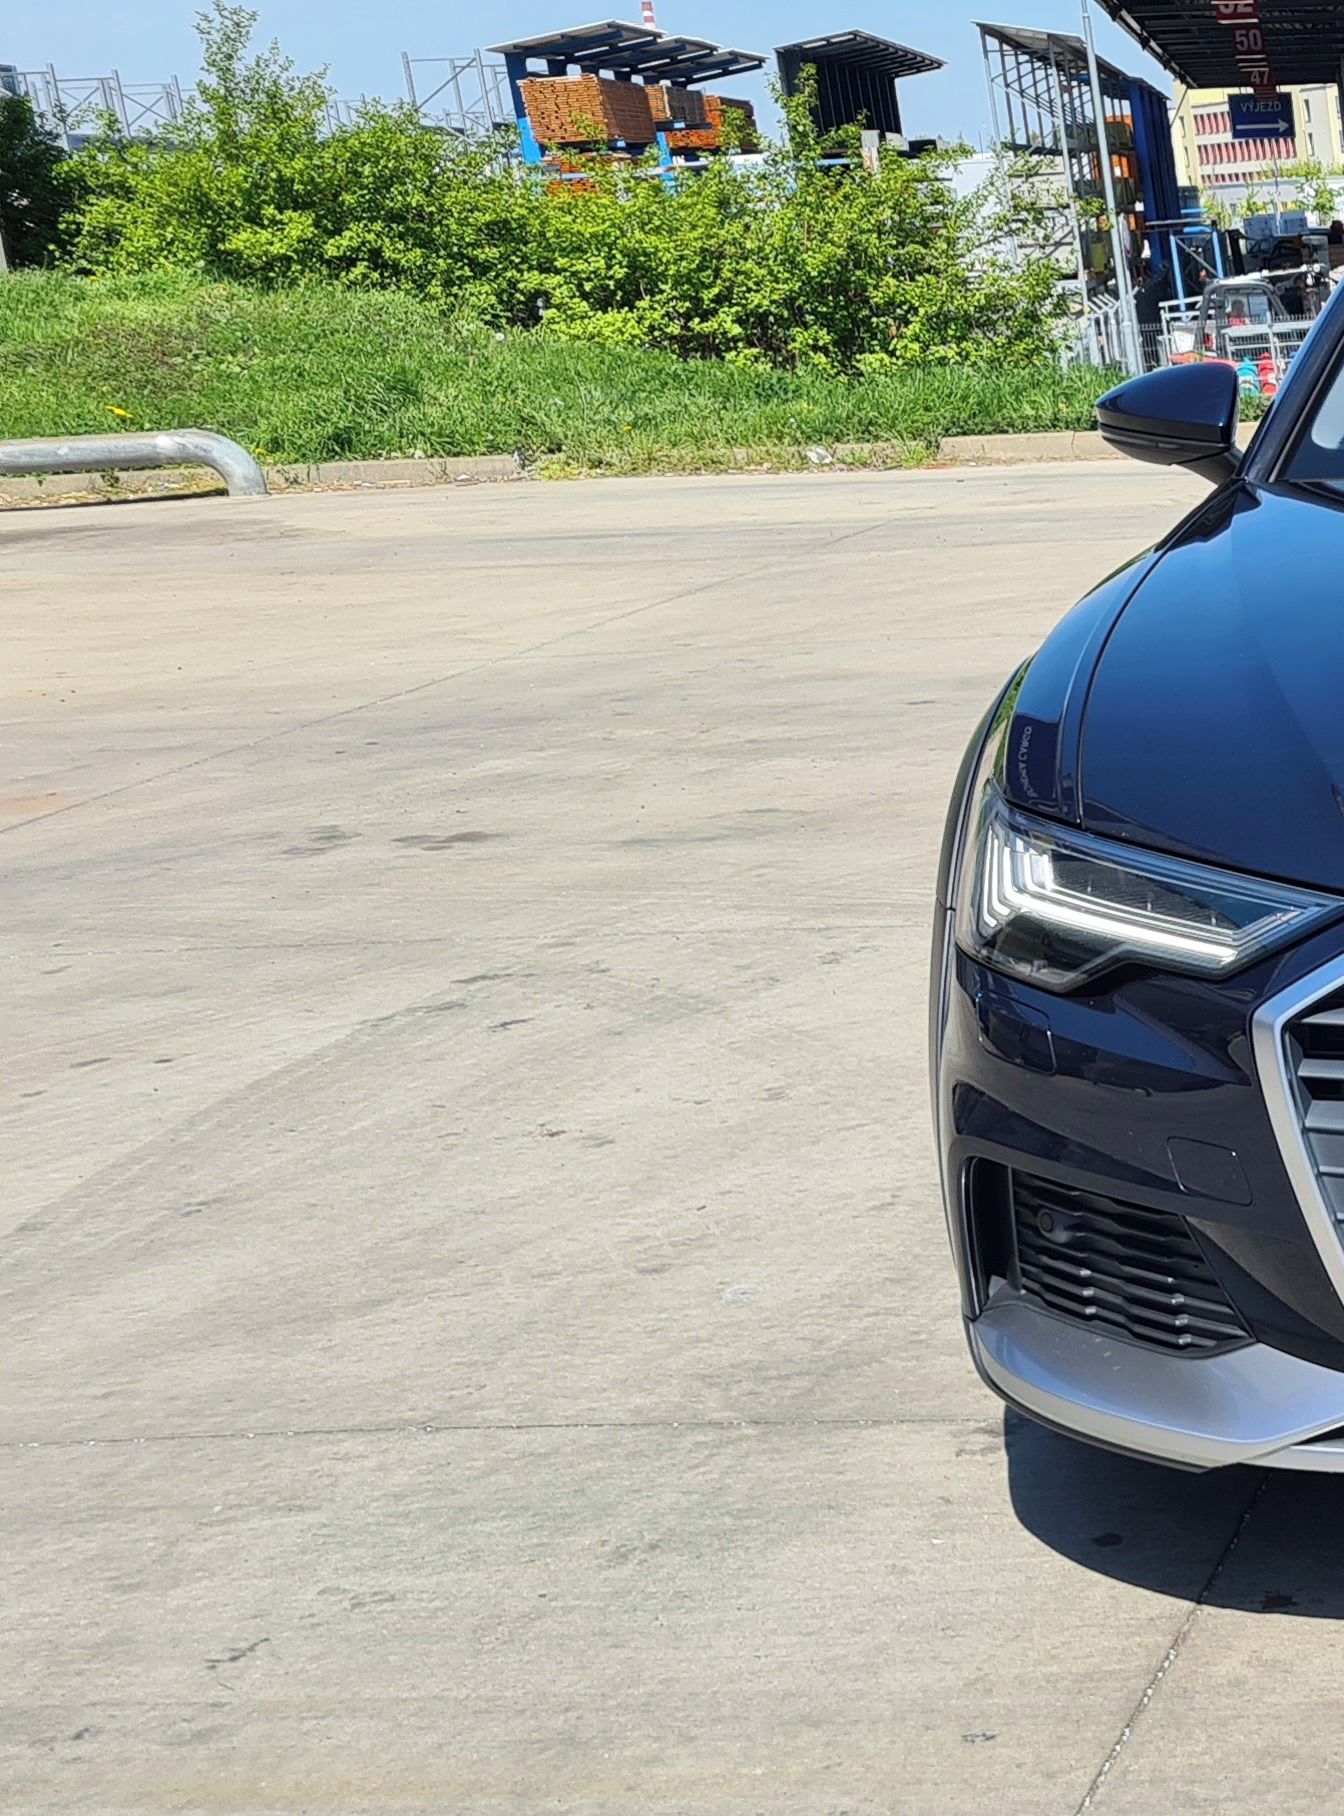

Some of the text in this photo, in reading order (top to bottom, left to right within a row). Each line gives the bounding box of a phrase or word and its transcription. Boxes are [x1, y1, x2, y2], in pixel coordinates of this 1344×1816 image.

[1234, 29, 1263, 51] 50
[1250, 70, 1270, 85] 47
[1240, 100, 1282, 112] VÝJEZD
